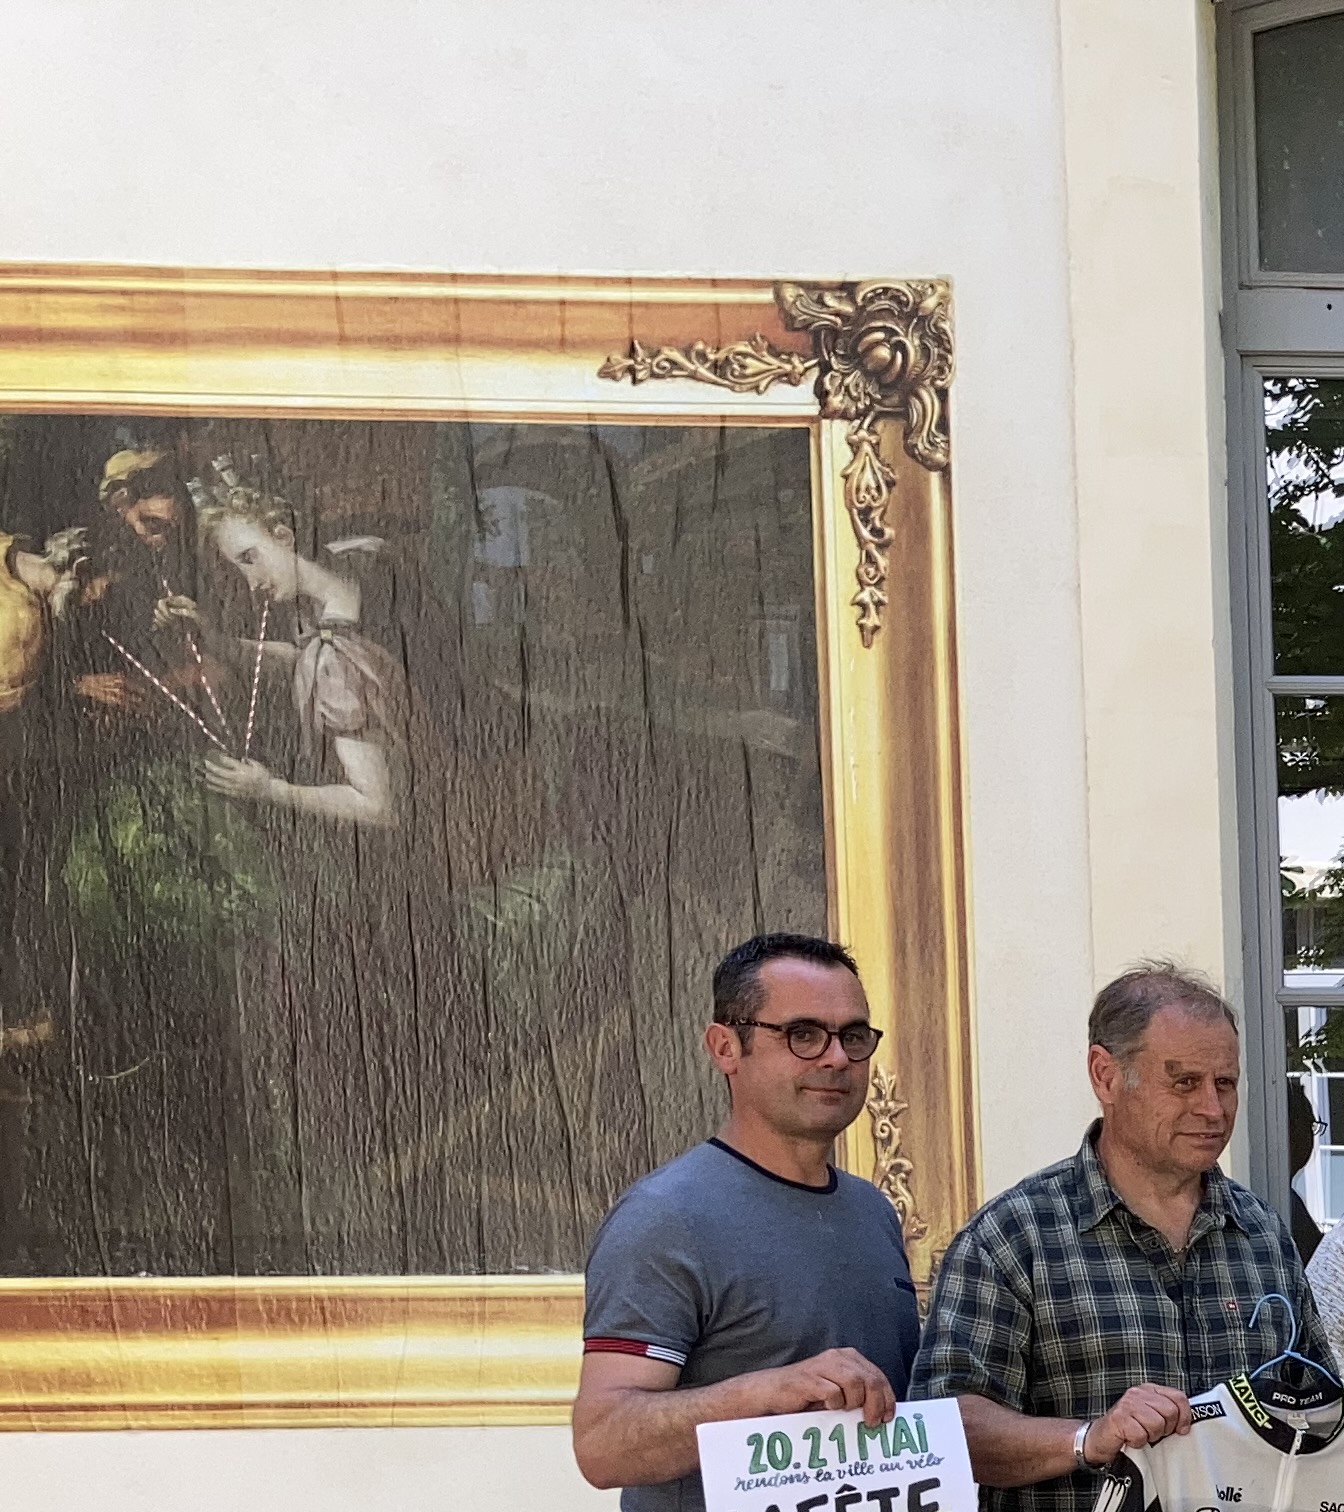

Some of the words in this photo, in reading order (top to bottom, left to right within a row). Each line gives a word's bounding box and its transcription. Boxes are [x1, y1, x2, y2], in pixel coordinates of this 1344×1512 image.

[1231, 1373, 1267, 1425] MAVIC
[1271, 1391, 1297, 1405] PRO
[1299, 1391, 1323, 1406] TEAM
[733, 1471, 811, 1492] rendons
[814, 1468, 835, 1483] la
[835, 1460, 875, 1481] ville
[879, 1461, 904, 1473] au
[905, 1452, 946, 1470] vélo
